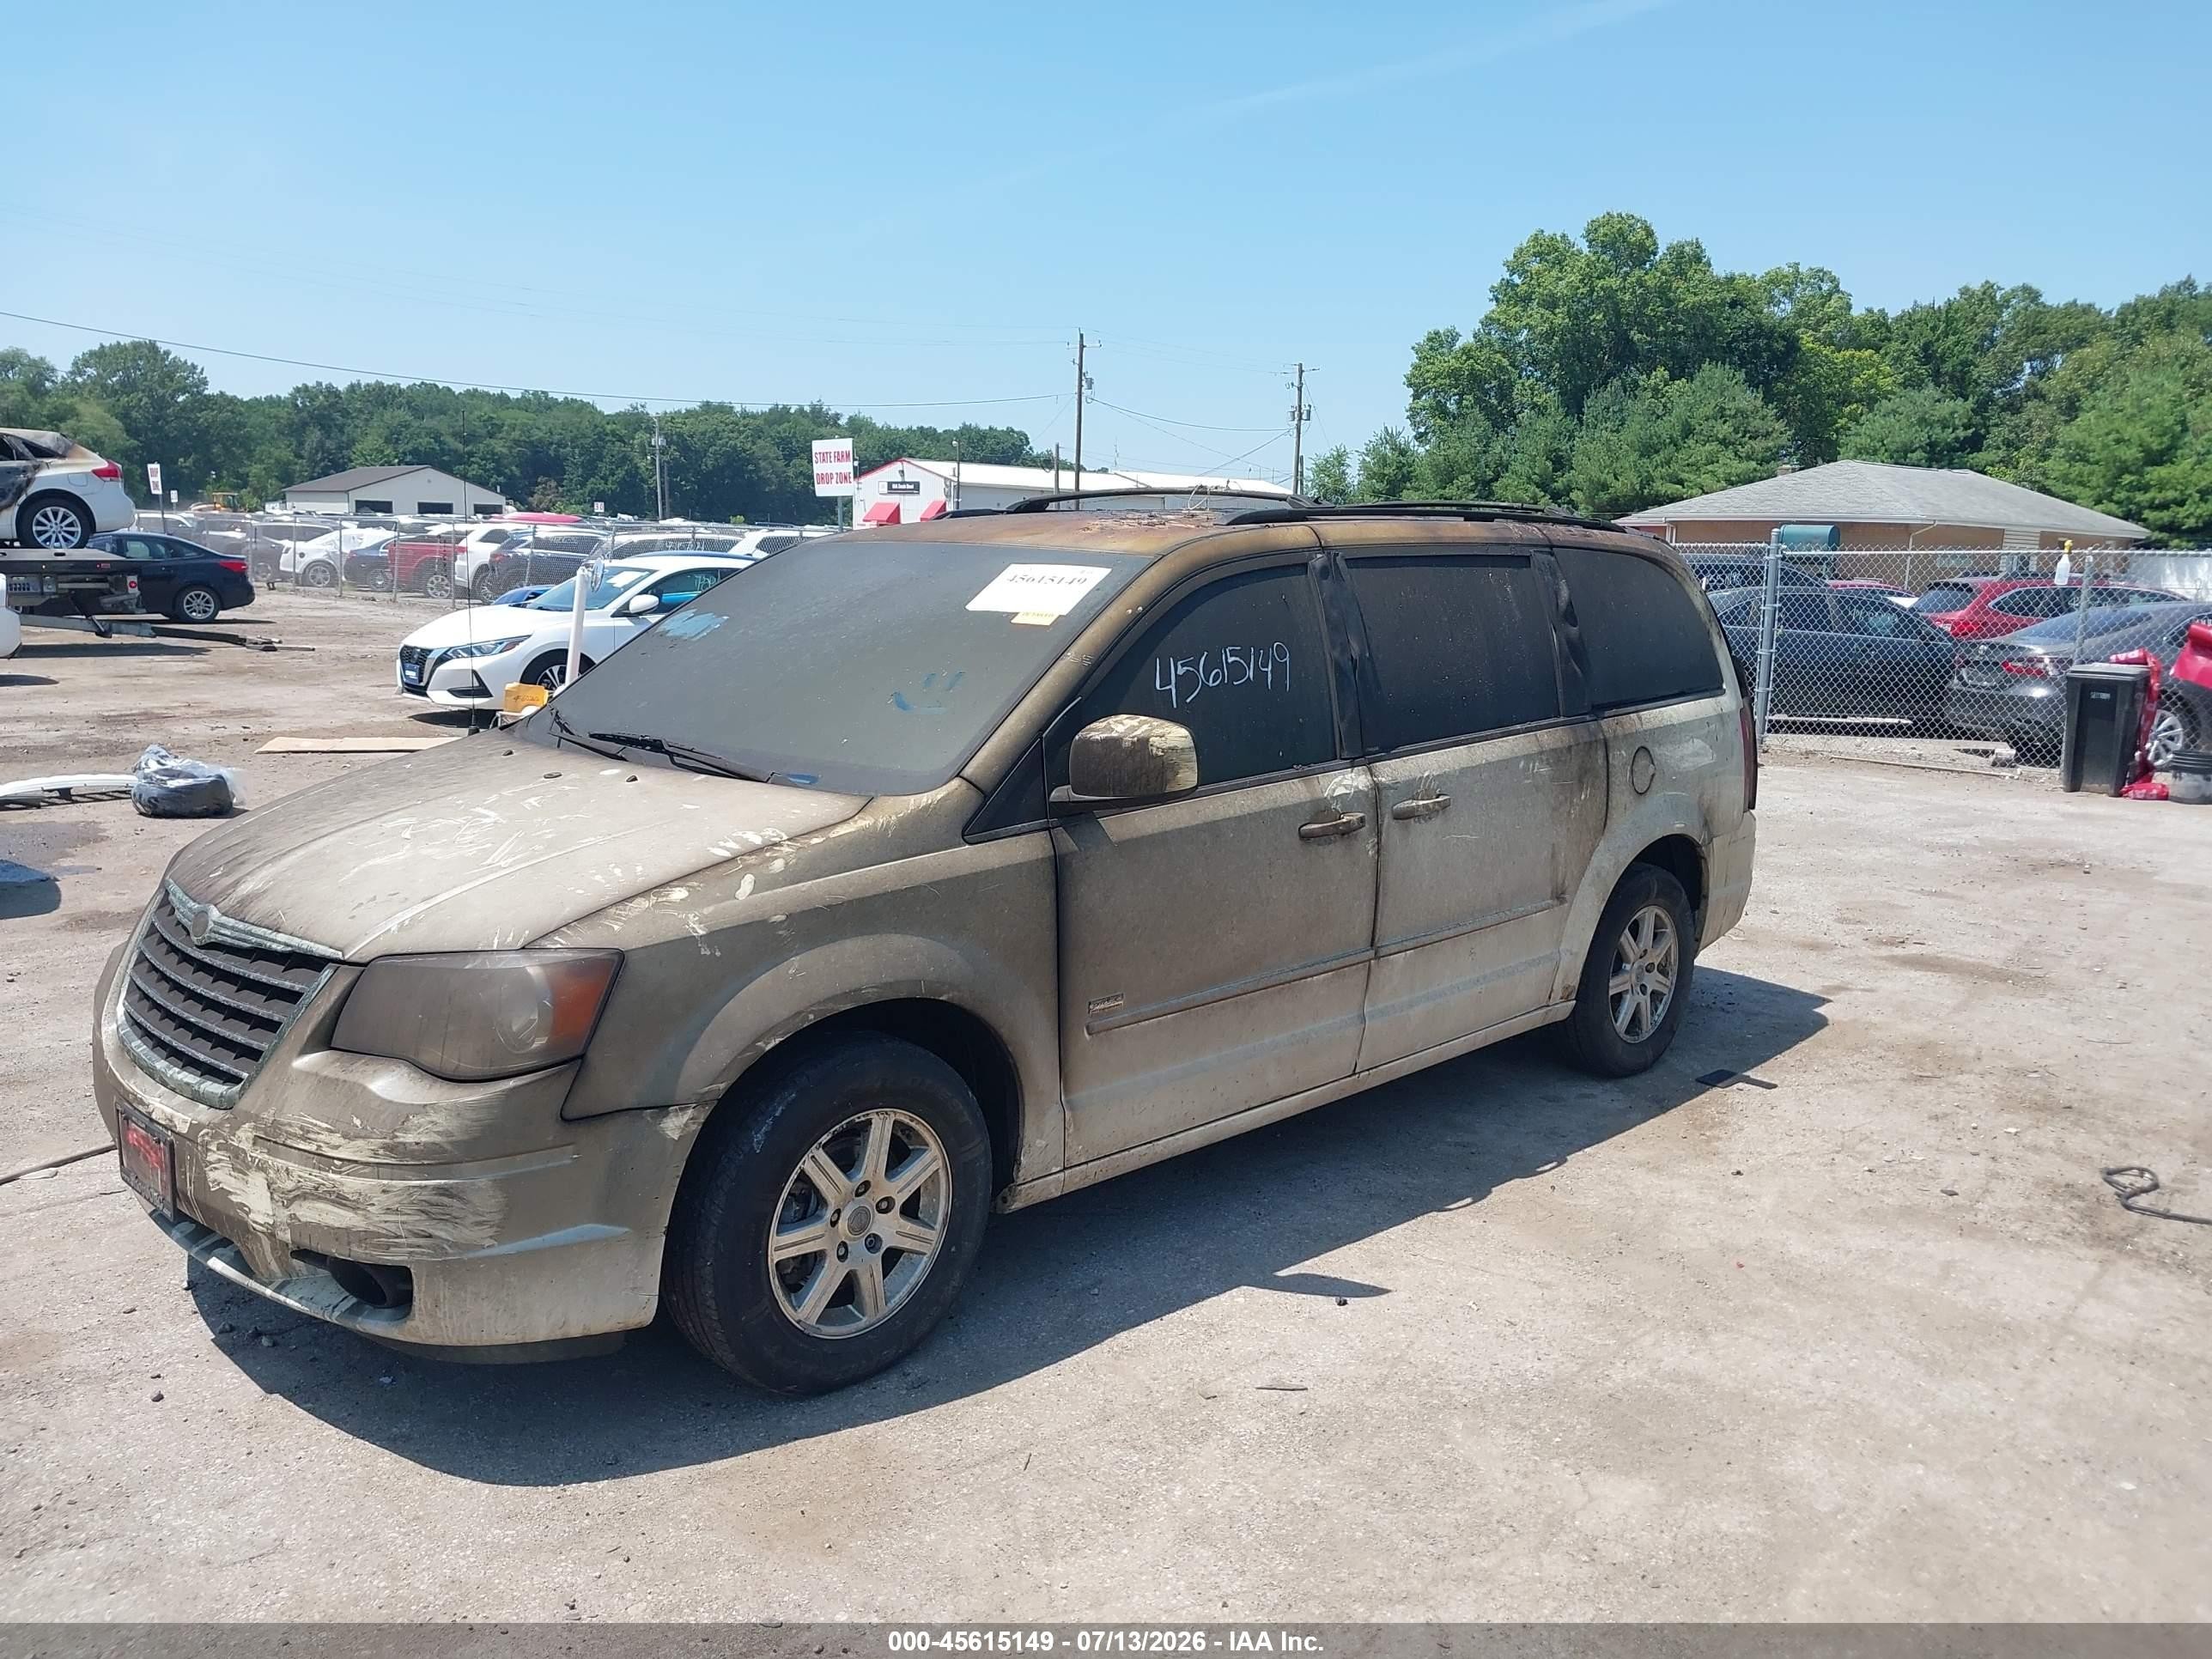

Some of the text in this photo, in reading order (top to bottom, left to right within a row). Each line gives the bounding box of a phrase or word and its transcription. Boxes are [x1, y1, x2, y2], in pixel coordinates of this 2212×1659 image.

[814, 450, 851, 464] STATE FARM
[816, 471, 853, 485] DROP ZONE
[1155, 641, 1290, 708] 45615149
